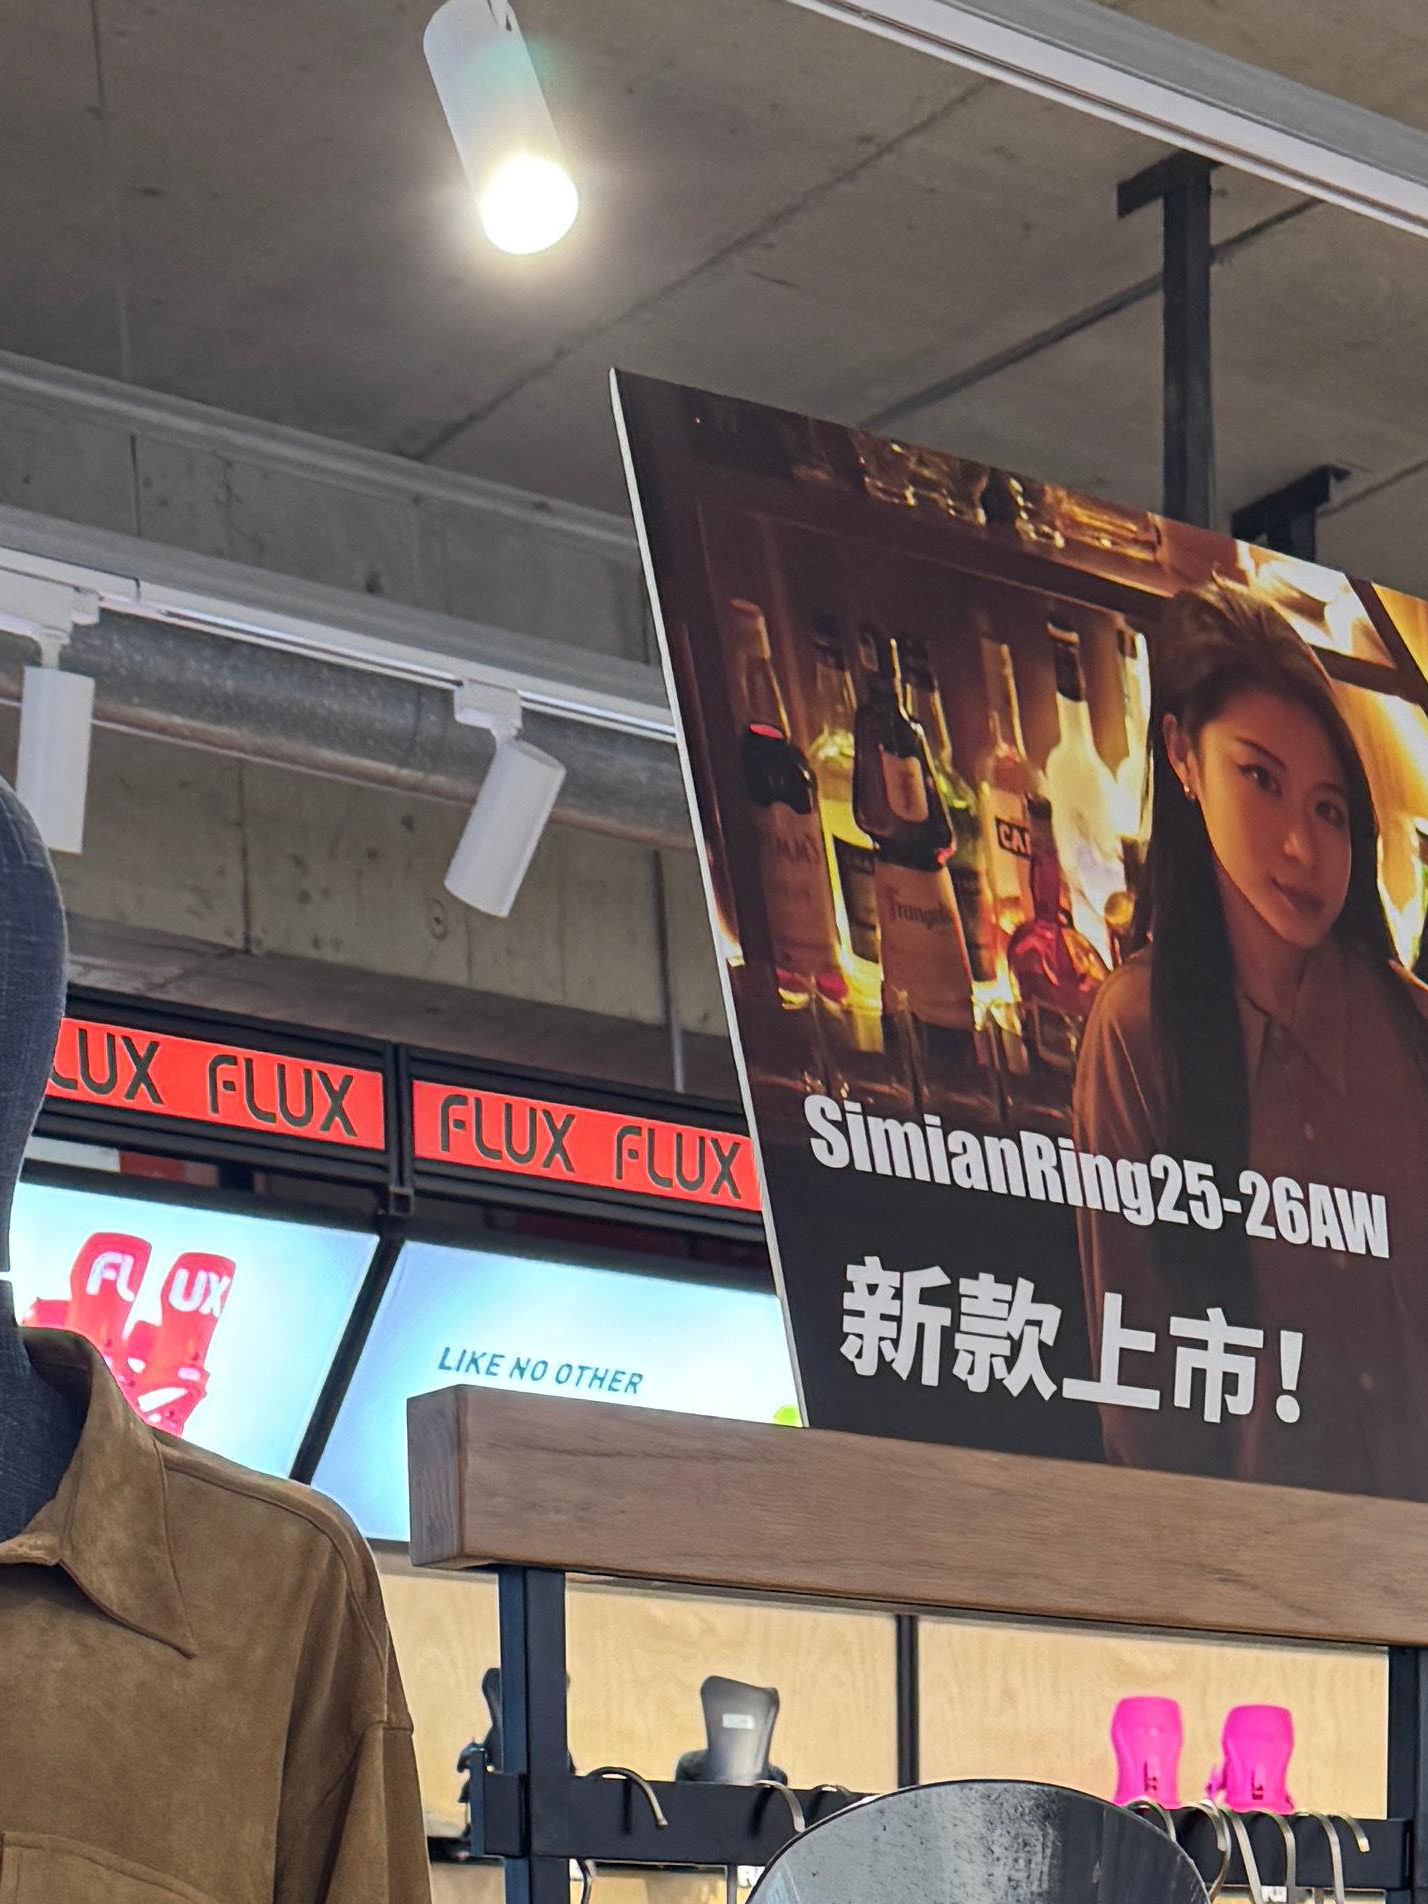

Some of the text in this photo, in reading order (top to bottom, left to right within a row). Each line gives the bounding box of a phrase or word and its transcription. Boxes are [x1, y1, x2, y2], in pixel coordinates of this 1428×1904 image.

[49, 1026, 356, 1138] UX FLUX
[440, 1094, 744, 1200] FLUX FLUX
[803, 1094, 1390, 1259] SimianRing25-26AW
[88, 1253, 139, 1304] FL
[438, 1347, 645, 1396] LIKE NO OTHER
[839, 1255, 1304, 1425] 新款上市！
